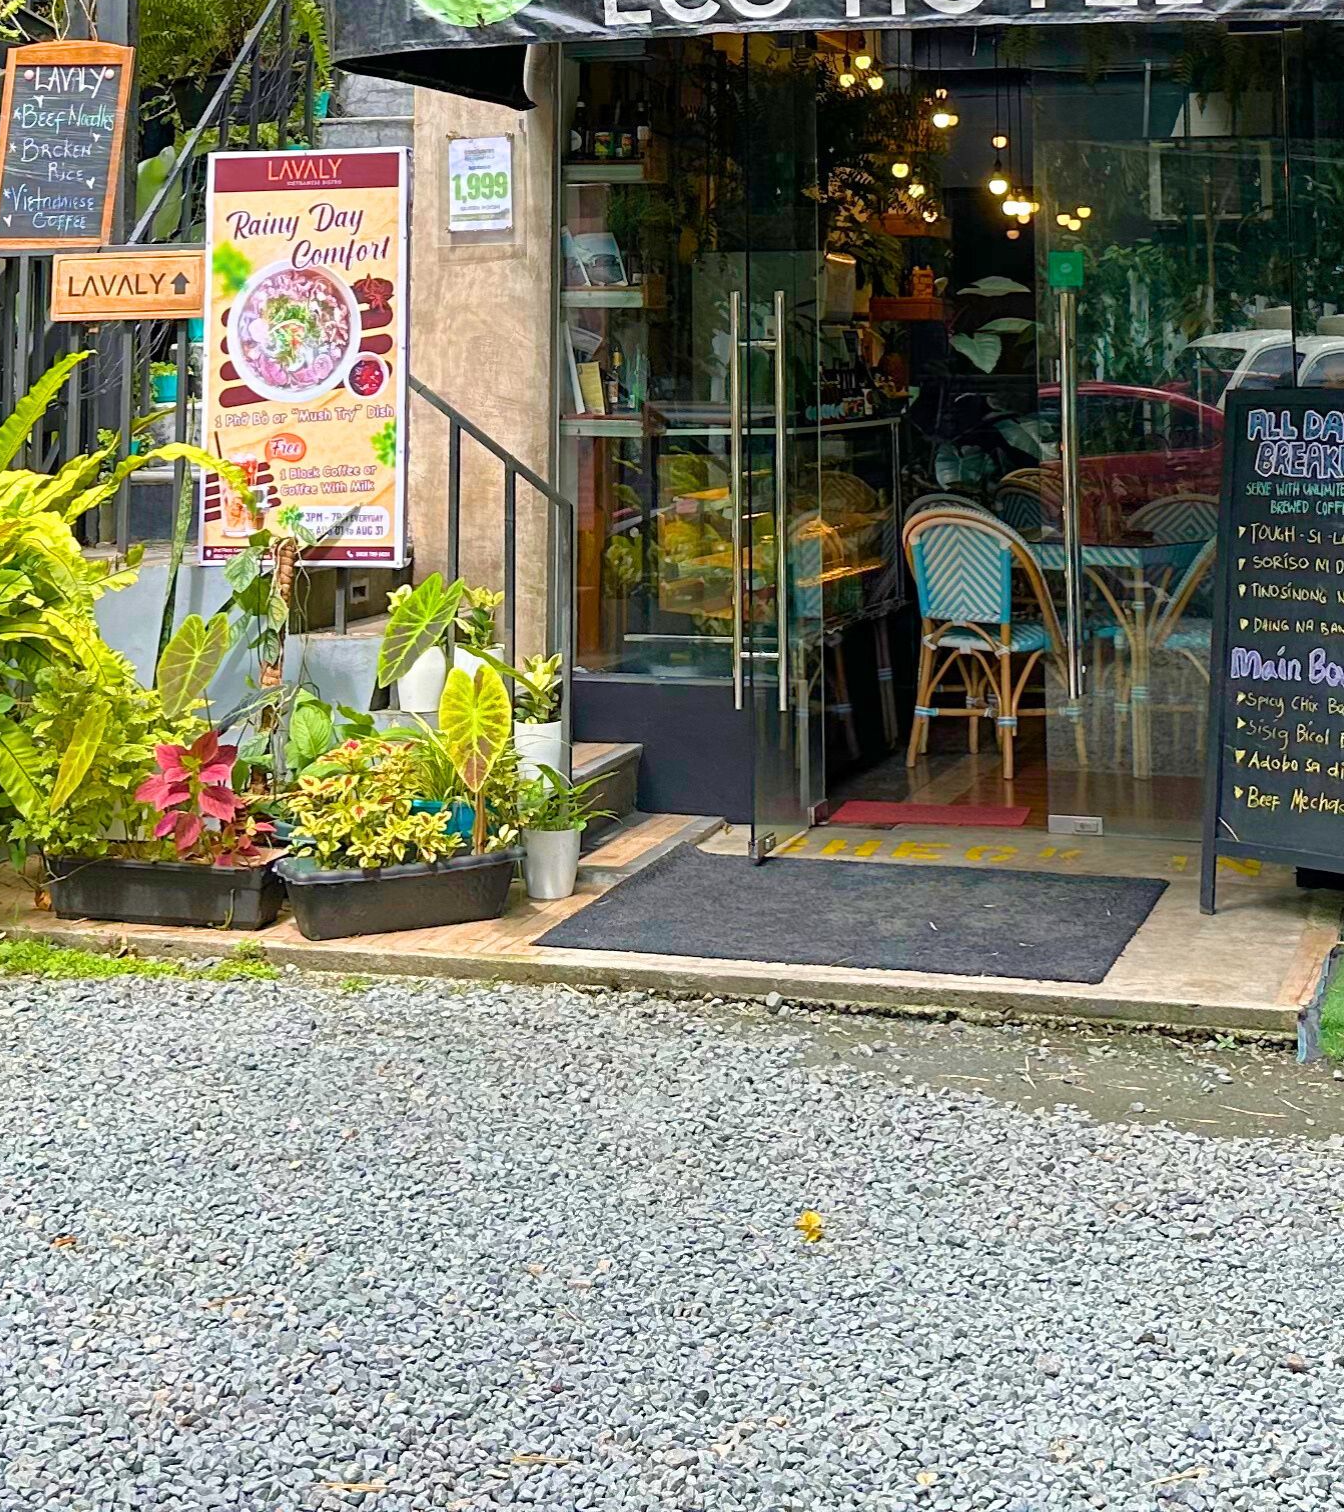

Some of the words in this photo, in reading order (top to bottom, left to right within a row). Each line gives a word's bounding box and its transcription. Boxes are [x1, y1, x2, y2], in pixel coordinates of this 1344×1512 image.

[34, 66, 106, 98] LAVALY
[268, 158, 343, 180] LAVALY
[452, 171, 508, 203] 1,999
[226, 210, 300, 241] Rainy
[308, 203, 364, 235] Day
[291, 236, 390, 271] Comfort
[68, 273, 166, 297] LAVALY
[272, 412, 288, 424] or
[1247, 408, 1298, 441] ALL
[270, 439, 301, 456] Free
[322, 465, 360, 478] Coffee
[363, 465, 377, 475] or
[280, 483, 317, 496] Coffee
[321, 482, 348, 494] With
[349, 480, 375, 493] Milk
[1276, 482, 1300, 496] WITH
[1270, 500, 1309, 515] BREWED
[356, 526, 372, 535] AUG
[1296, 619, 1315, 633] NA
[1248, 751, 1298, 772] Adobo
